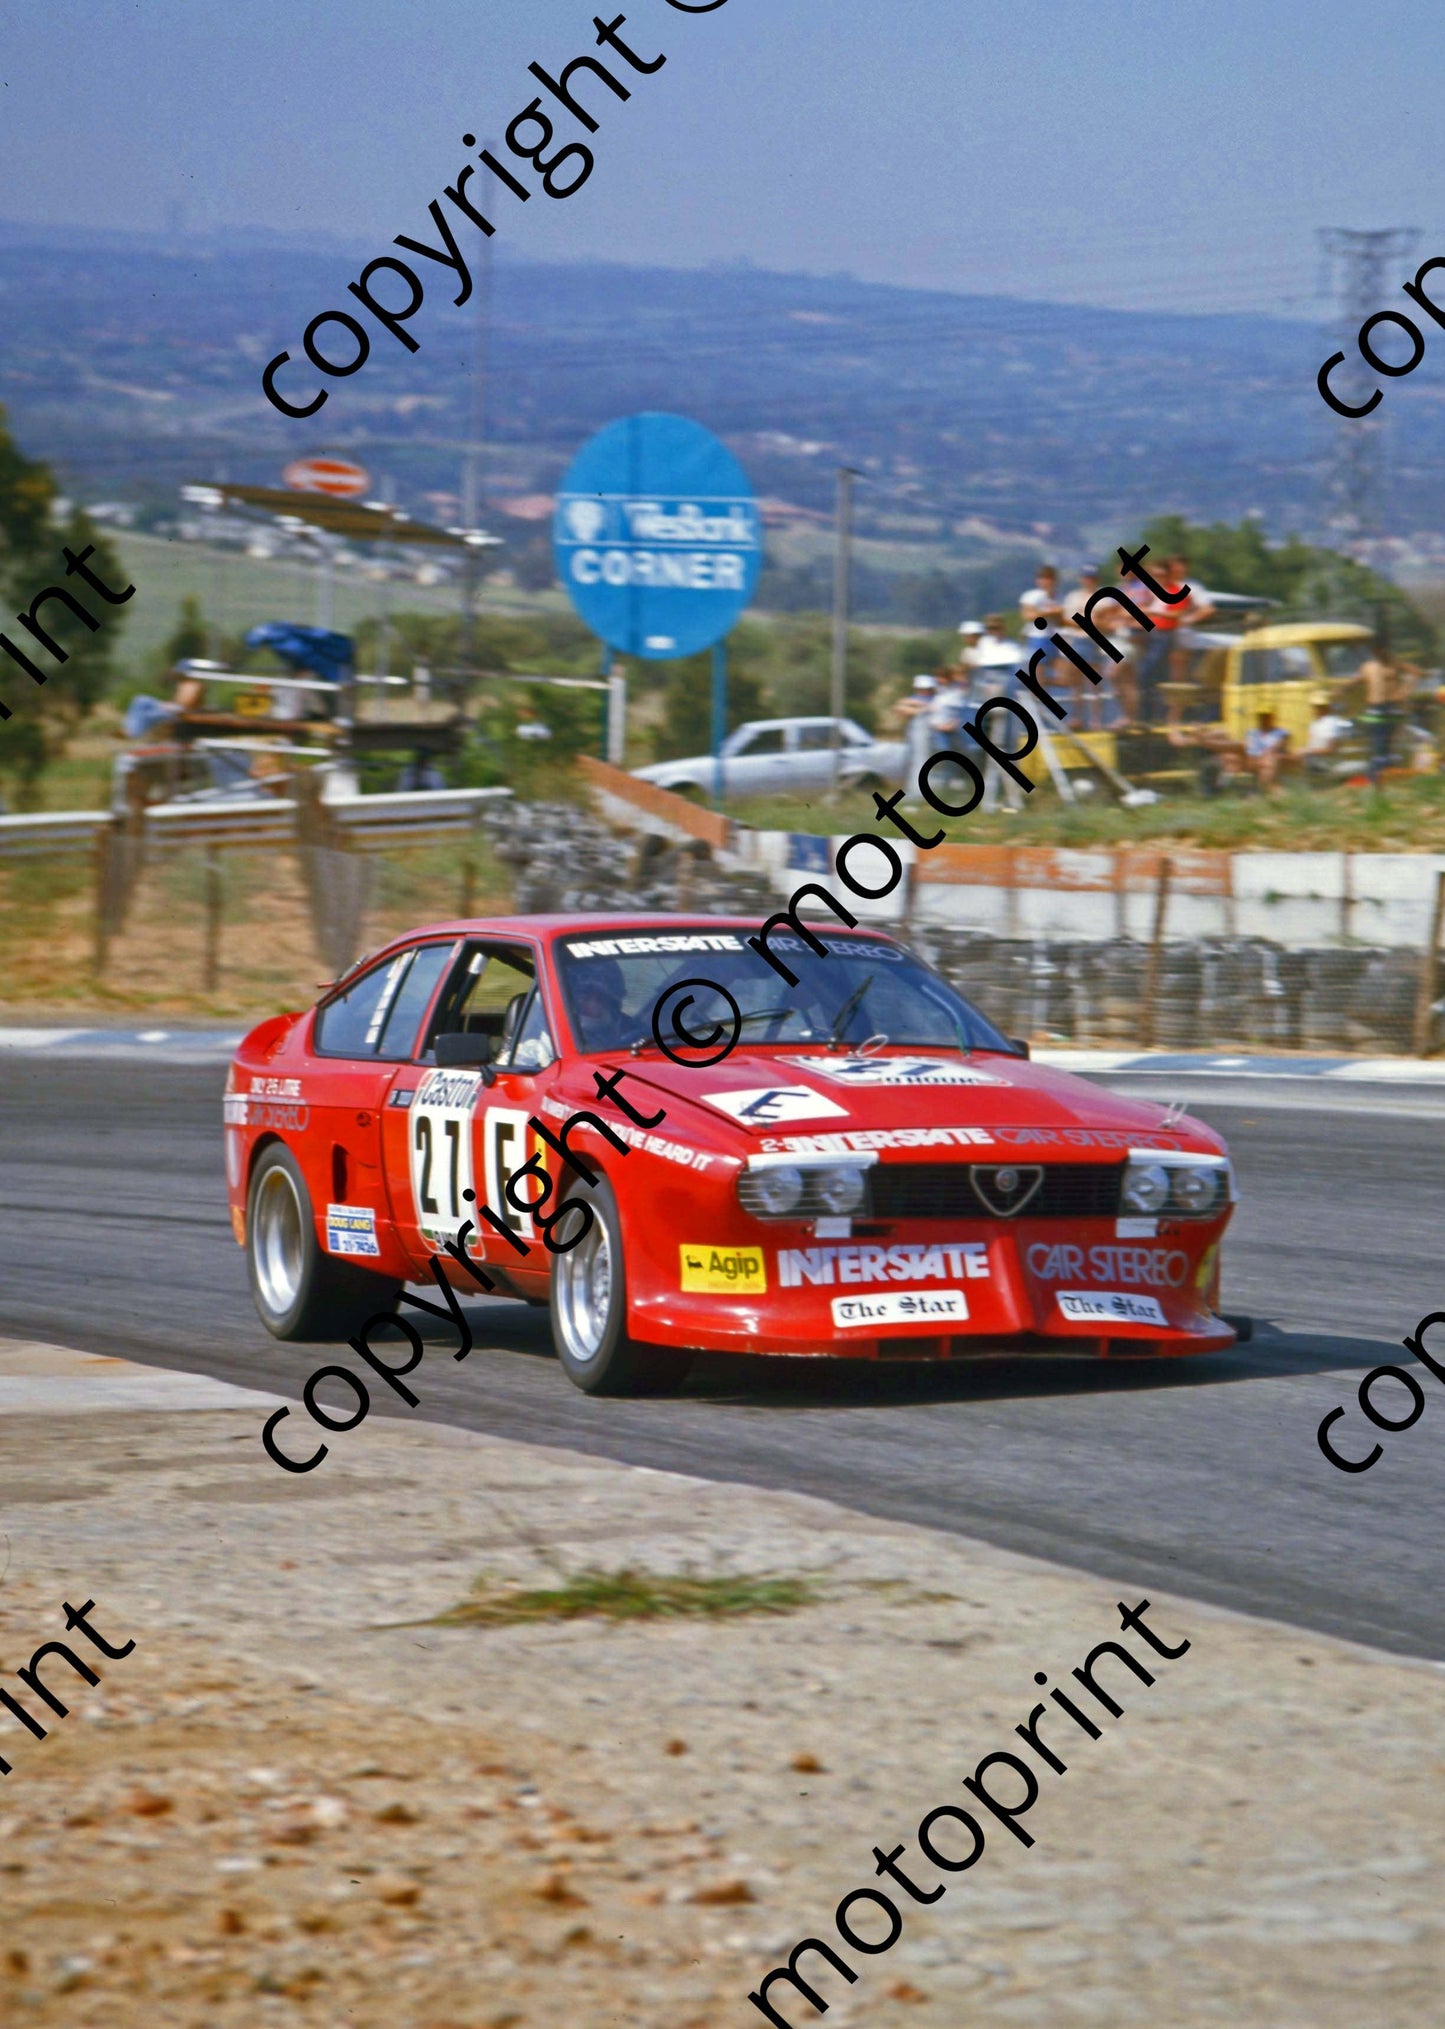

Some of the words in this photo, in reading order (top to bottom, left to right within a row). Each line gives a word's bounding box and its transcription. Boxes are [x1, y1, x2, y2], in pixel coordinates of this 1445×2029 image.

[571, 549, 745, 591] CORNER
[566, 935, 744, 959] INTERSTATE
[834, 1059, 945, 1076] 27
[738, 1090, 809, 1119] E
[793, 1127, 995, 1152] INTERSTATE
[416, 1115, 460, 1218] 27
[495, 1121, 523, 1231] E
[708, 1250, 759, 1280] Agip
[777, 1243, 990, 1288] INTERSTATE
[1027, 1243, 1087, 1281] CAR
[1088, 1245, 1189, 1288] STEREO
[838, 1302, 887, 1320] The
[898, 1296, 957, 1315] Star
[1063, 1296, 1104, 1314] The
[1112, 1296, 1158, 1319] Star
